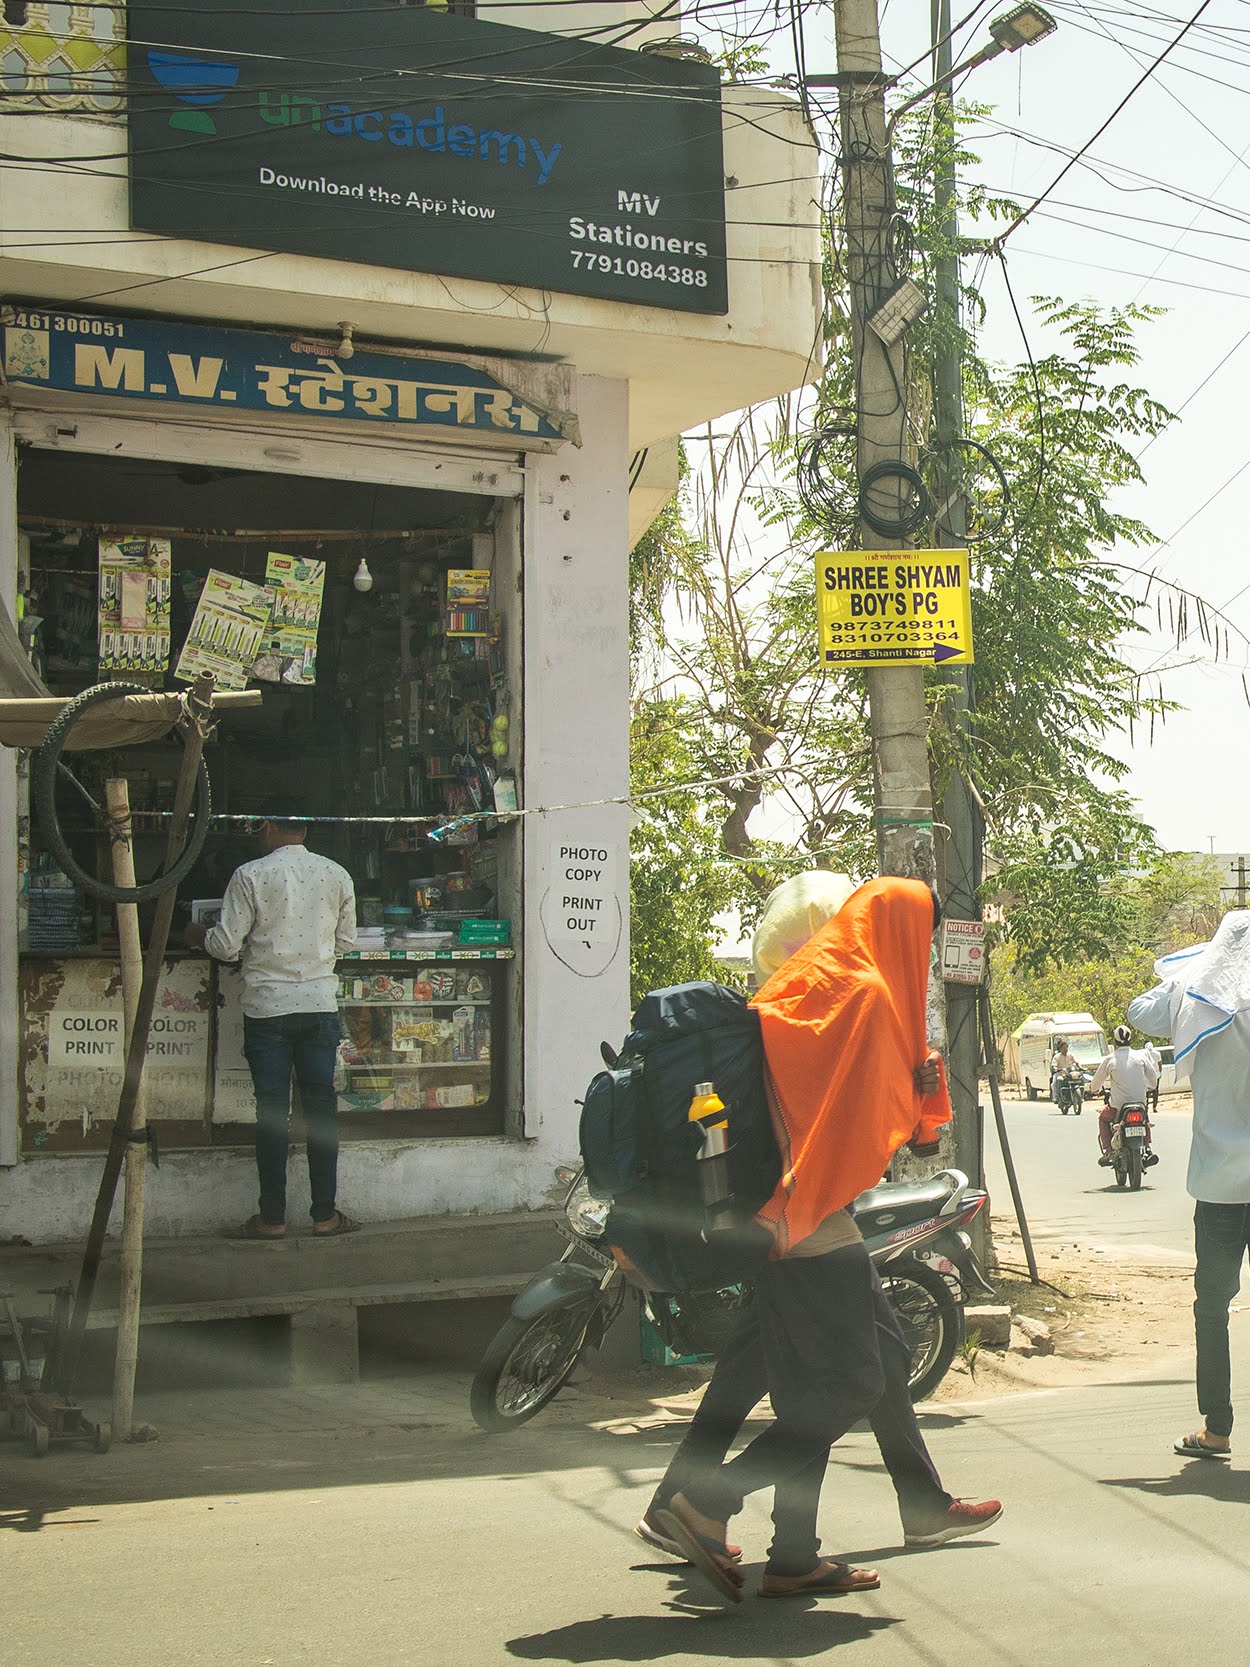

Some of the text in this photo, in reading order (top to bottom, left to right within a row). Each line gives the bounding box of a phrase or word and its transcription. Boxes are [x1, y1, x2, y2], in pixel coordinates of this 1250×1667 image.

[258, 91, 562, 186] unacademy
[259, 167, 496, 220] Download the App Now
[617, 189, 661, 217] MV
[569, 217, 708, 259] Stationers
[570, 250, 709, 288] 7791084388
[824, 565, 961, 591] SHREE SHYAM
[851, 592, 939, 617] BOY'S PG
[831, 619, 956, 632] 9873749811
[832, 632, 960, 644] 8310703364
[869, 649, 903, 658] Shanti
[905, 648, 937, 660] Nagar
[560, 846, 608, 862] PHOTO
[565, 868, 602, 882] COPY
[562, 896, 603, 911] PRINT
[567, 917, 597, 932] OUT
[947, 922, 973, 933] NOTICE
[62, 1017, 119, 1033] COLOR
[65, 1040, 116, 1055] PRINT
[147, 1041, 194, 1056] PRINT
